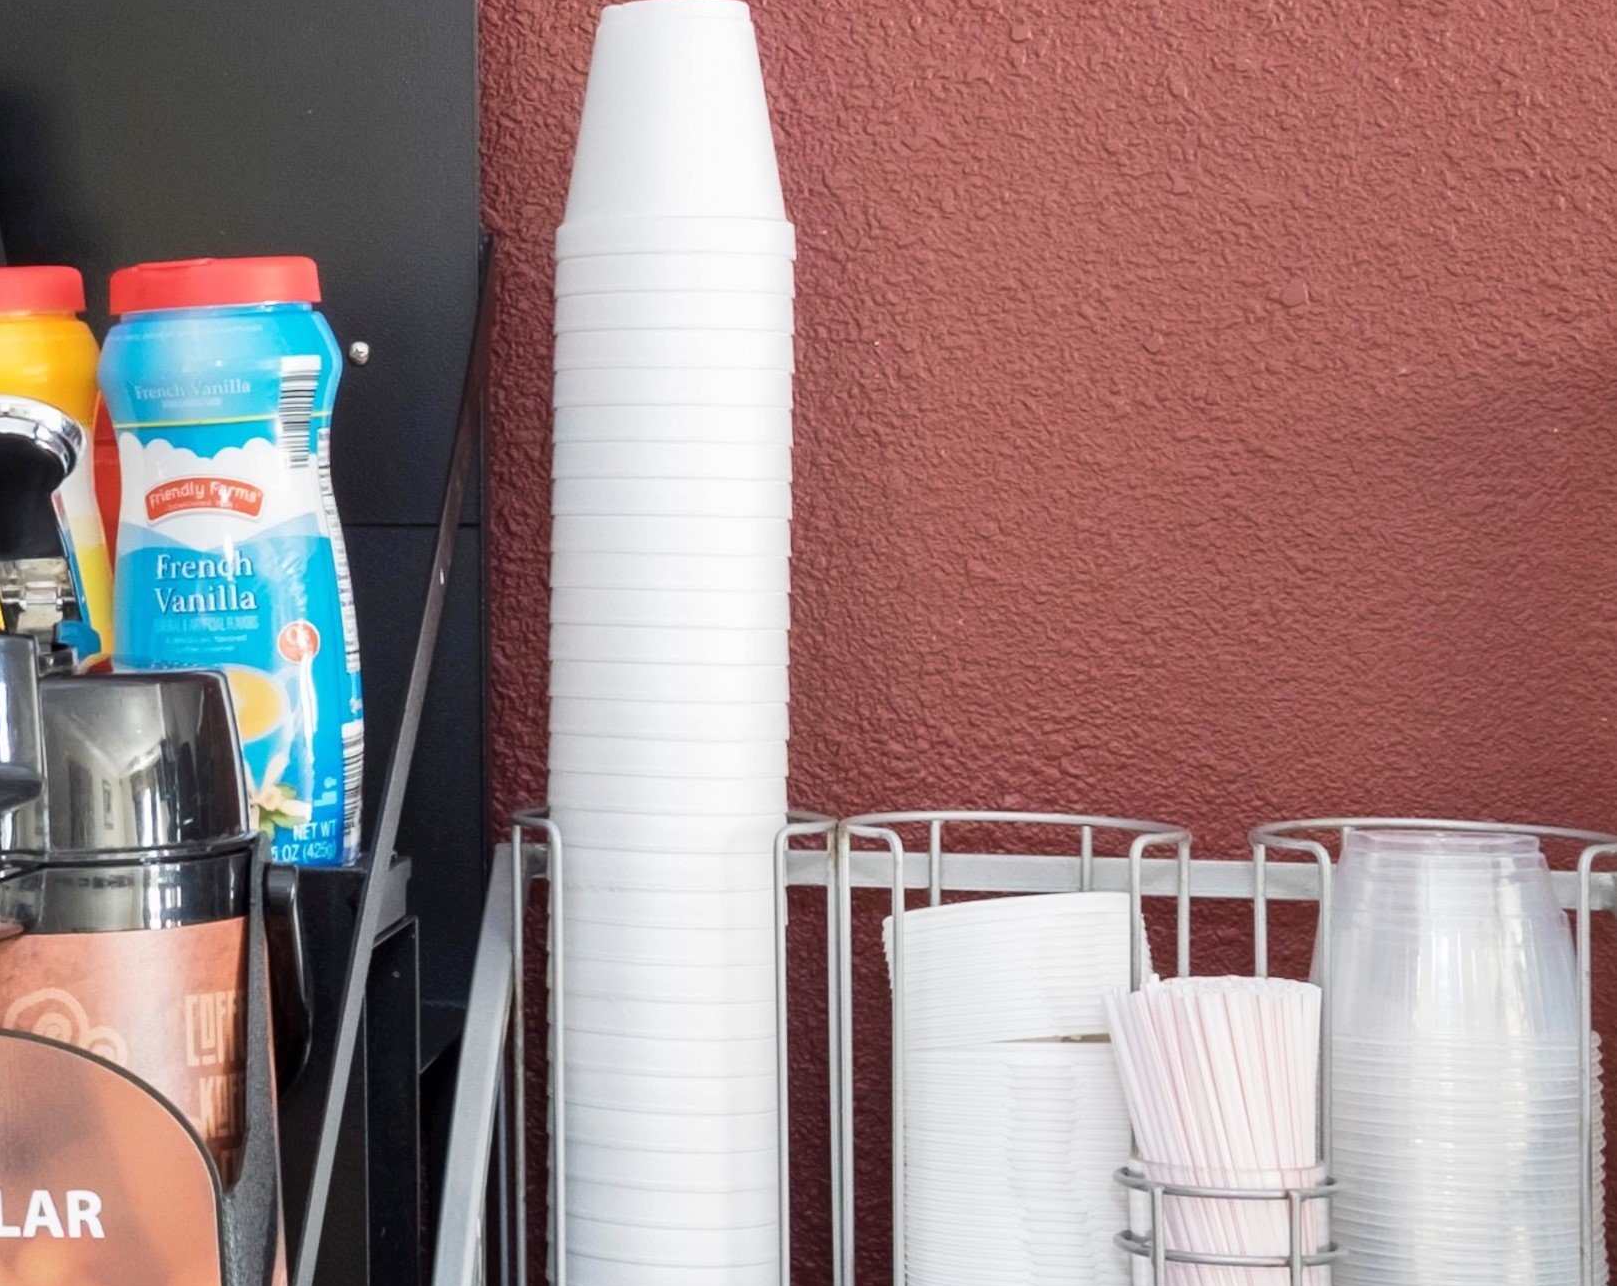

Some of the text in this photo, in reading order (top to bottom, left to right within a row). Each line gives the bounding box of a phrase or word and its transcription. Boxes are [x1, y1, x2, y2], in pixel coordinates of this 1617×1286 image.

[149, 481, 205, 509] Friendly
[157, 551, 254, 580] French
[155, 584, 257, 613] Vanilla
[293, 819, 336, 841] NET WT
